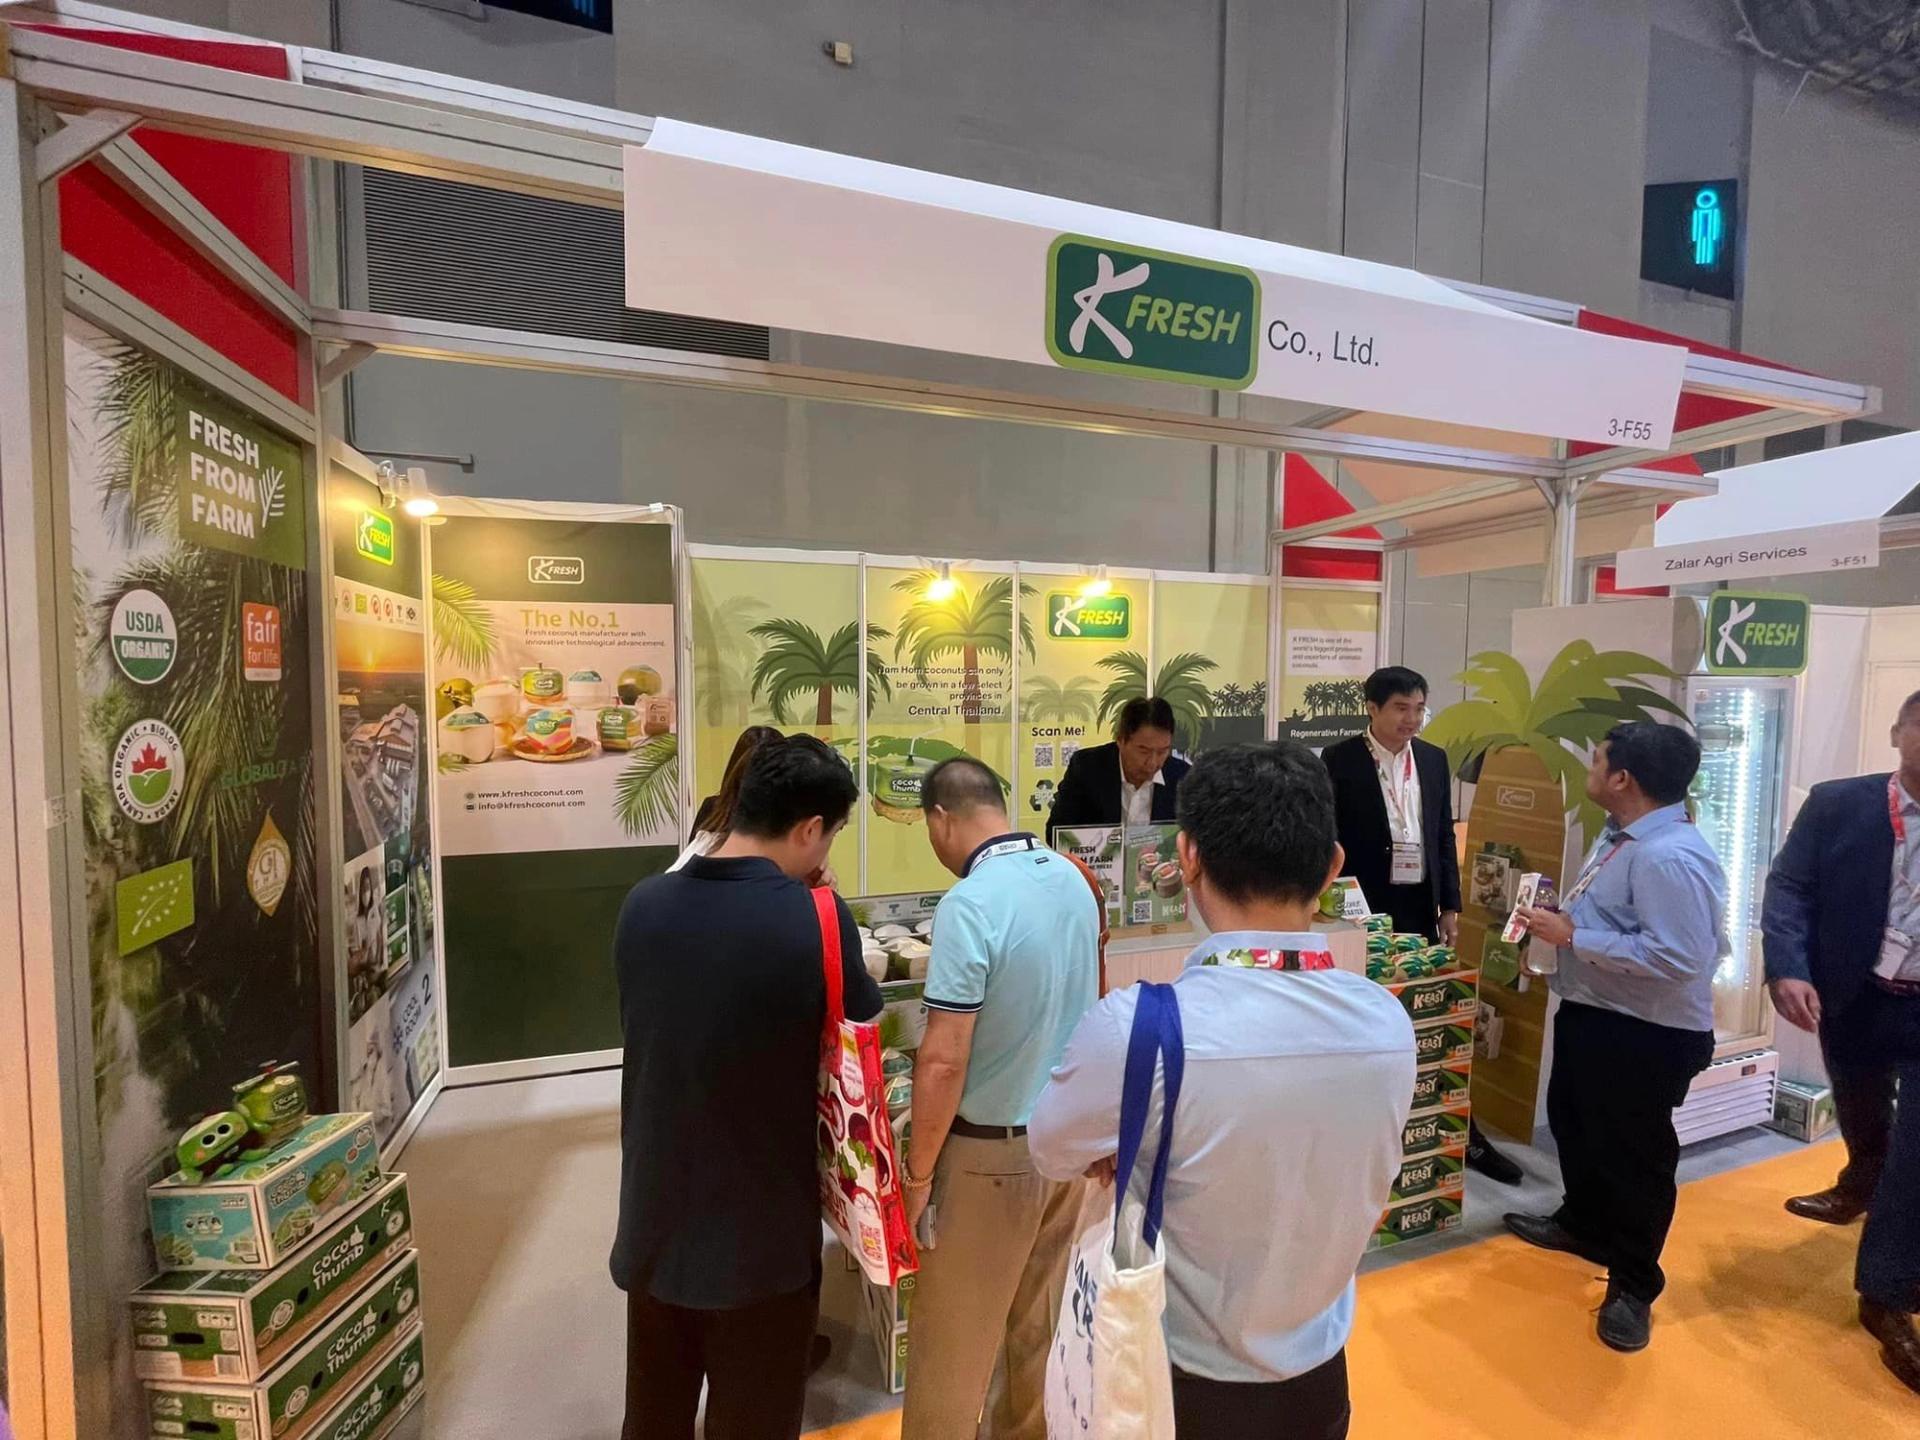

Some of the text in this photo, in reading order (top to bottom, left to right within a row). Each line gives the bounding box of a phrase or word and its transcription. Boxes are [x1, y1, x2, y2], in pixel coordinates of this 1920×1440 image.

[1124, 295, 1241, 346] FRESH
[1267, 320, 1323, 358] Co.,
[1332, 330, 1381, 368] Ltd.
[1607, 417, 1653, 442] 3-F55
[189, 410, 260, 469] FRESH
[190, 452, 257, 504] FROM
[191, 493, 256, 540] FARM
[1664, 545, 1808, 571] Zalar Agri Services
[1831, 555, 1867, 568] 3-F51
[548, 565, 579, 576] FRESH
[125, 609, 164, 634] USDA
[247, 610, 278, 643] fair
[520, 609, 620, 628] The No.1
[1076, 609, 1125, 627] FRESH
[548, 629, 578, 637] coconut
[1742, 622, 1800, 648] FRESH
[120, 638, 170, 661] ORGANIC
[247, 647, 280, 665] for life
[924, 666, 965, 675] coconuts
[985, 666, 1004, 677] only
[896, 680, 908, 689] be
[910, 681, 939, 691] grown
[940, 680, 949, 689] in
[949, 691, 1003, 701] provinces in
[908, 705, 1005, 716] Central Thailand.
[1031, 725, 1086, 737] Scan Me!
[1290, 729, 1338, 739] Regenerative
[478, 789, 584, 799] www.kfreshcoconut.com
[478, 800, 586, 811] info@kfreshcoconut.com
[1069, 846, 1096, 856] FRESH
[1089, 856, 1114, 864] FARM
[313, 1244, 365, 1291] Thumb
[327, 1325, 376, 1374] Thumb
